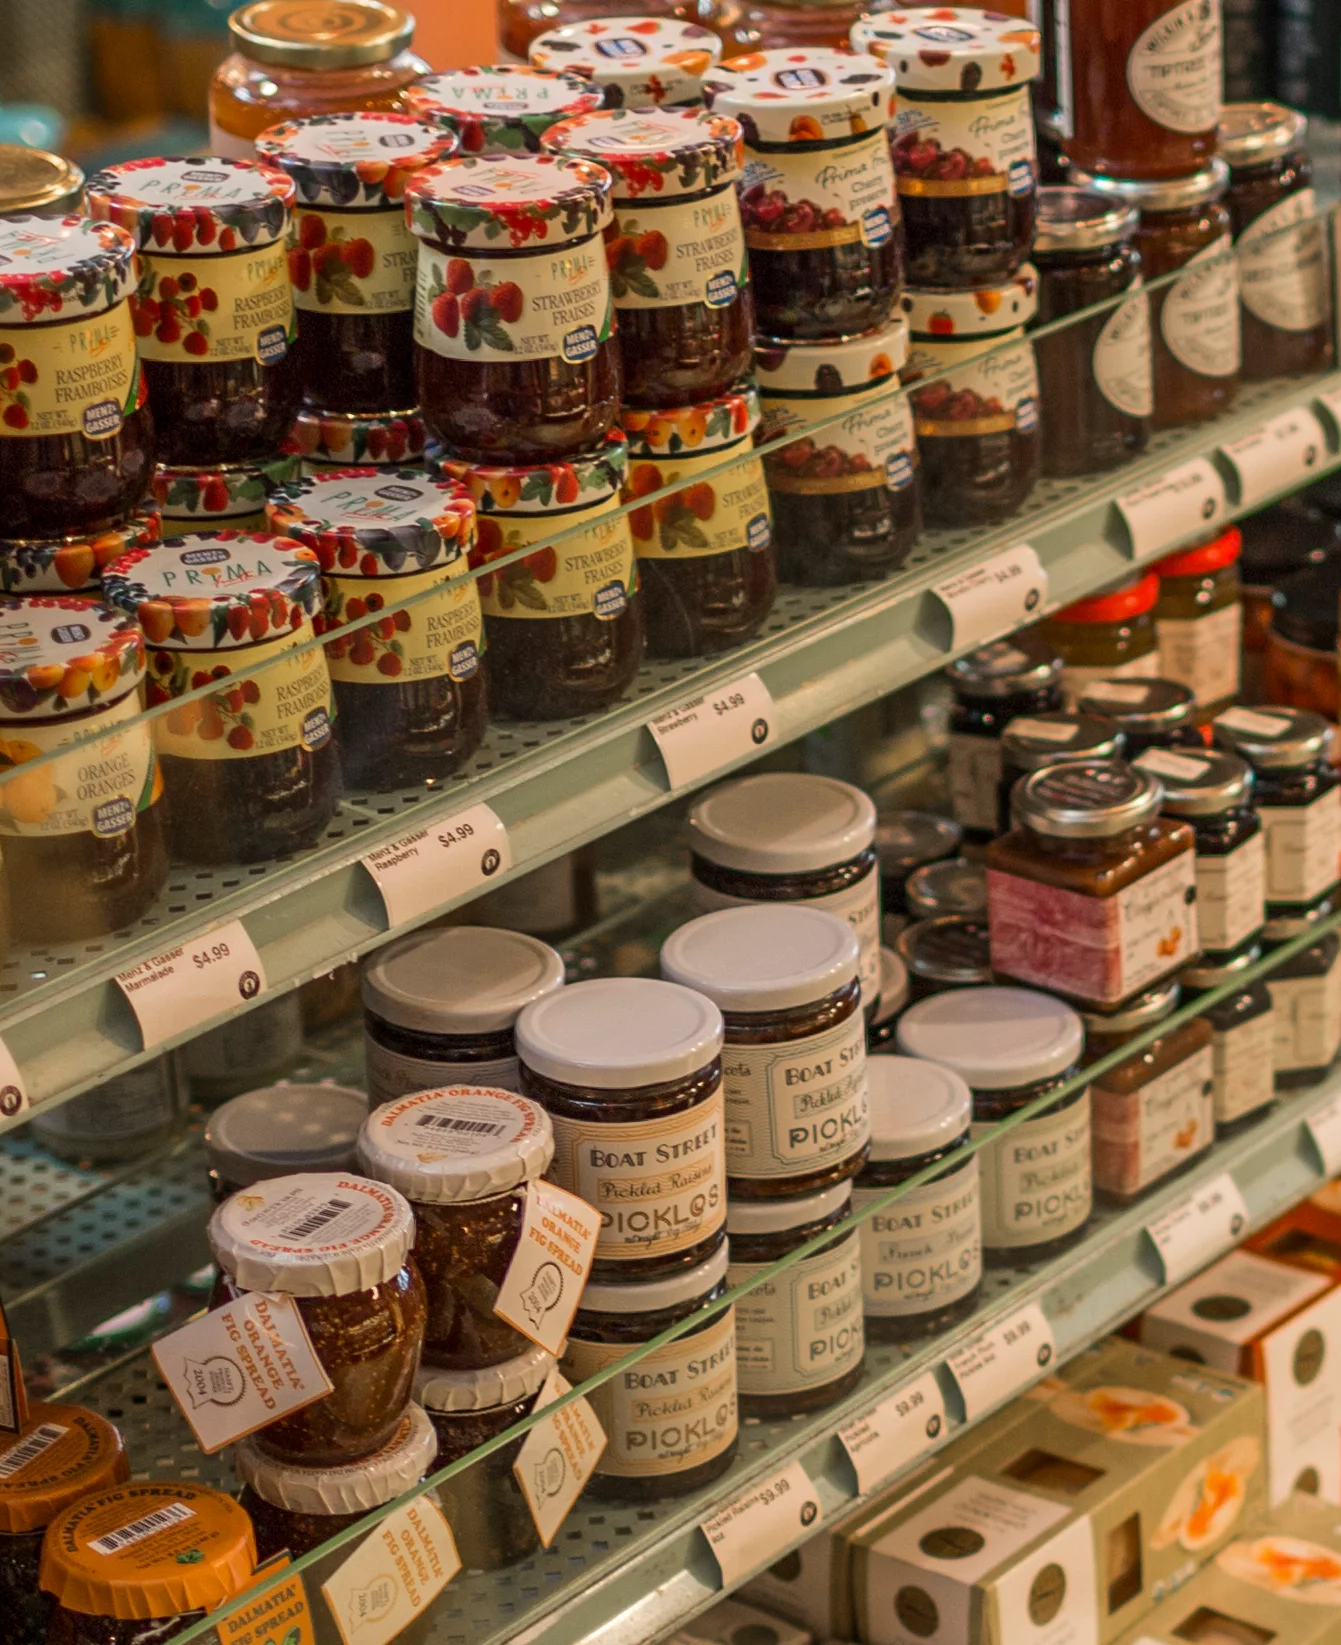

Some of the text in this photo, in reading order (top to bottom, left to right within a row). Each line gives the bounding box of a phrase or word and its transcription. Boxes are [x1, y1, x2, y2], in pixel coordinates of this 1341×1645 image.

[234, 286, 287, 315] RASPBERRY
[531, 282, 602, 314] STRAWBERRY
[232, 303, 292, 332] FRAMBOISES
[552, 303, 597, 327] FRAISES
[565, 339, 598, 358] GASSER
[54, 354, 124, 385] RASPBERRY
[54, 373, 130, 404] FRAMBOISES
[85, 414, 121, 436] GASSER
[162, 559, 273, 588] PRIMA
[583, 561, 625, 586] FRAISES
[713, 693, 746, 716] $4.99
[656, 712, 699, 736] Strawberry
[77, 752, 130, 781] ORANGE
[76, 770, 137, 801] ORANGES
[95, 810, 135, 834] GASSER
[437, 823, 476, 849] $4.99
[367, 847, 391, 863] Menz
[400, 829, 430, 848] Gasser
[374, 846, 420, 872] Raspberry
[117, 947, 186, 983] Menz & Gasser
[192, 942, 231, 970] $4.99
[124, 965, 176, 994] Marmalade
[784, 1057, 834, 1087] BOAT
[380, 1089, 445, 1128] DALMATIA
[448, 1088, 514, 1102] ORANGE
[512, 1098, 532, 1113] FIG
[589, 1122, 718, 1169] BOAT STREET
[603, 1163, 713, 1199] Pickled Raisins
[336, 1180, 395, 1212] DALMATIA
[352, 1211, 395, 1246] ORANGE
[541, 1216, 582, 1255] ORANGE
[871, 1214, 923, 1234] BOAT
[318, 1243, 349, 1252] FIG
[528, 1226, 584, 1277] FIG SPREAD
[808, 1273, 847, 1300] BOAT
[221, 1312, 242, 1343] FIG
[236, 1344, 277, 1411] SPREAD
[243, 1319, 284, 1391] ORANGE
[193, 1369, 208, 1396] 2004
[624, 1369, 680, 1391] BOAT
[633, 1396, 693, 1419] Pickled
[895, 1391, 924, 1417] $9.99
[759, 1478, 791, 1506] $9.99
[62, 1487, 198, 1552] DALMATIA FIG SPREAD
[704, 1512, 733, 1532] Pickled
[400, 1529, 430, 1586] ORANGE
[406, 1507, 443, 1579] DALMATIA
[381, 1529, 422, 1608] FIG SPREAD
[226, 1585, 297, 1634] DALMATIA
[254, 1600, 306, 1639] SPREAD
